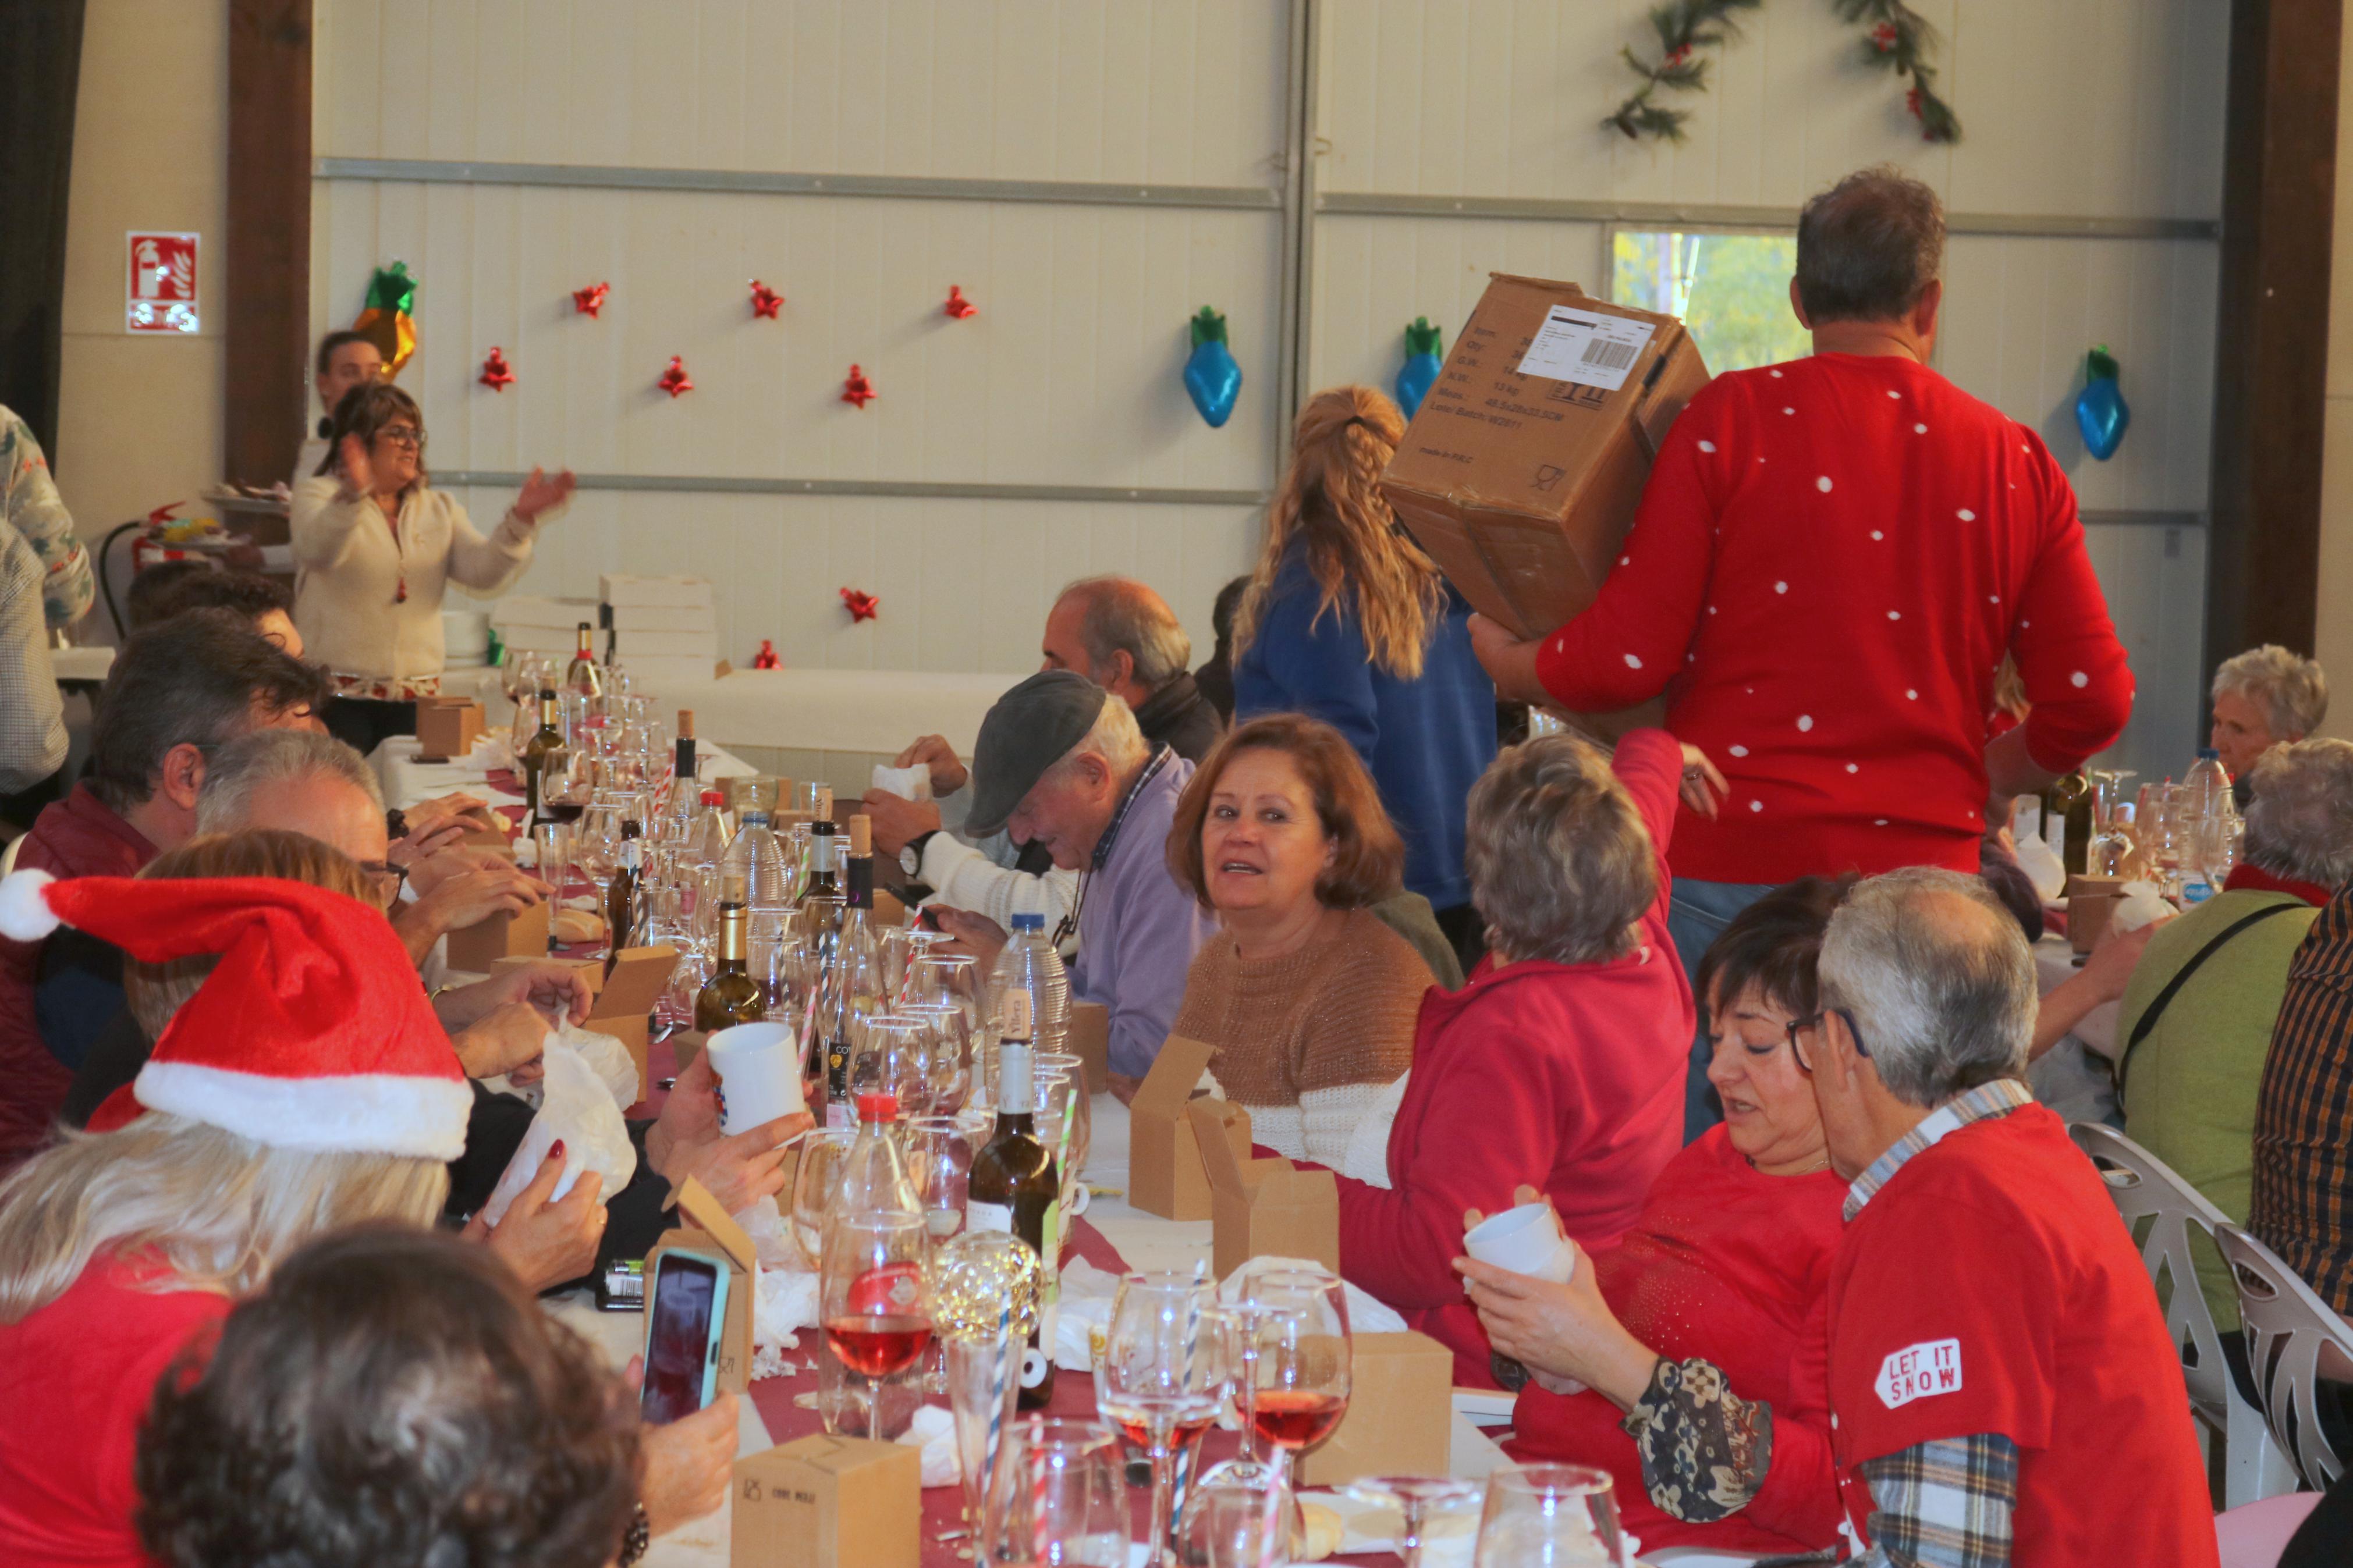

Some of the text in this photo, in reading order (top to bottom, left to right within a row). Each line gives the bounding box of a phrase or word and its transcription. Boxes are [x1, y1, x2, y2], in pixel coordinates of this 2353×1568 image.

[1890, 1346, 1953, 1379] LET IT
[1891, 1368, 1954, 1401] SNOW
